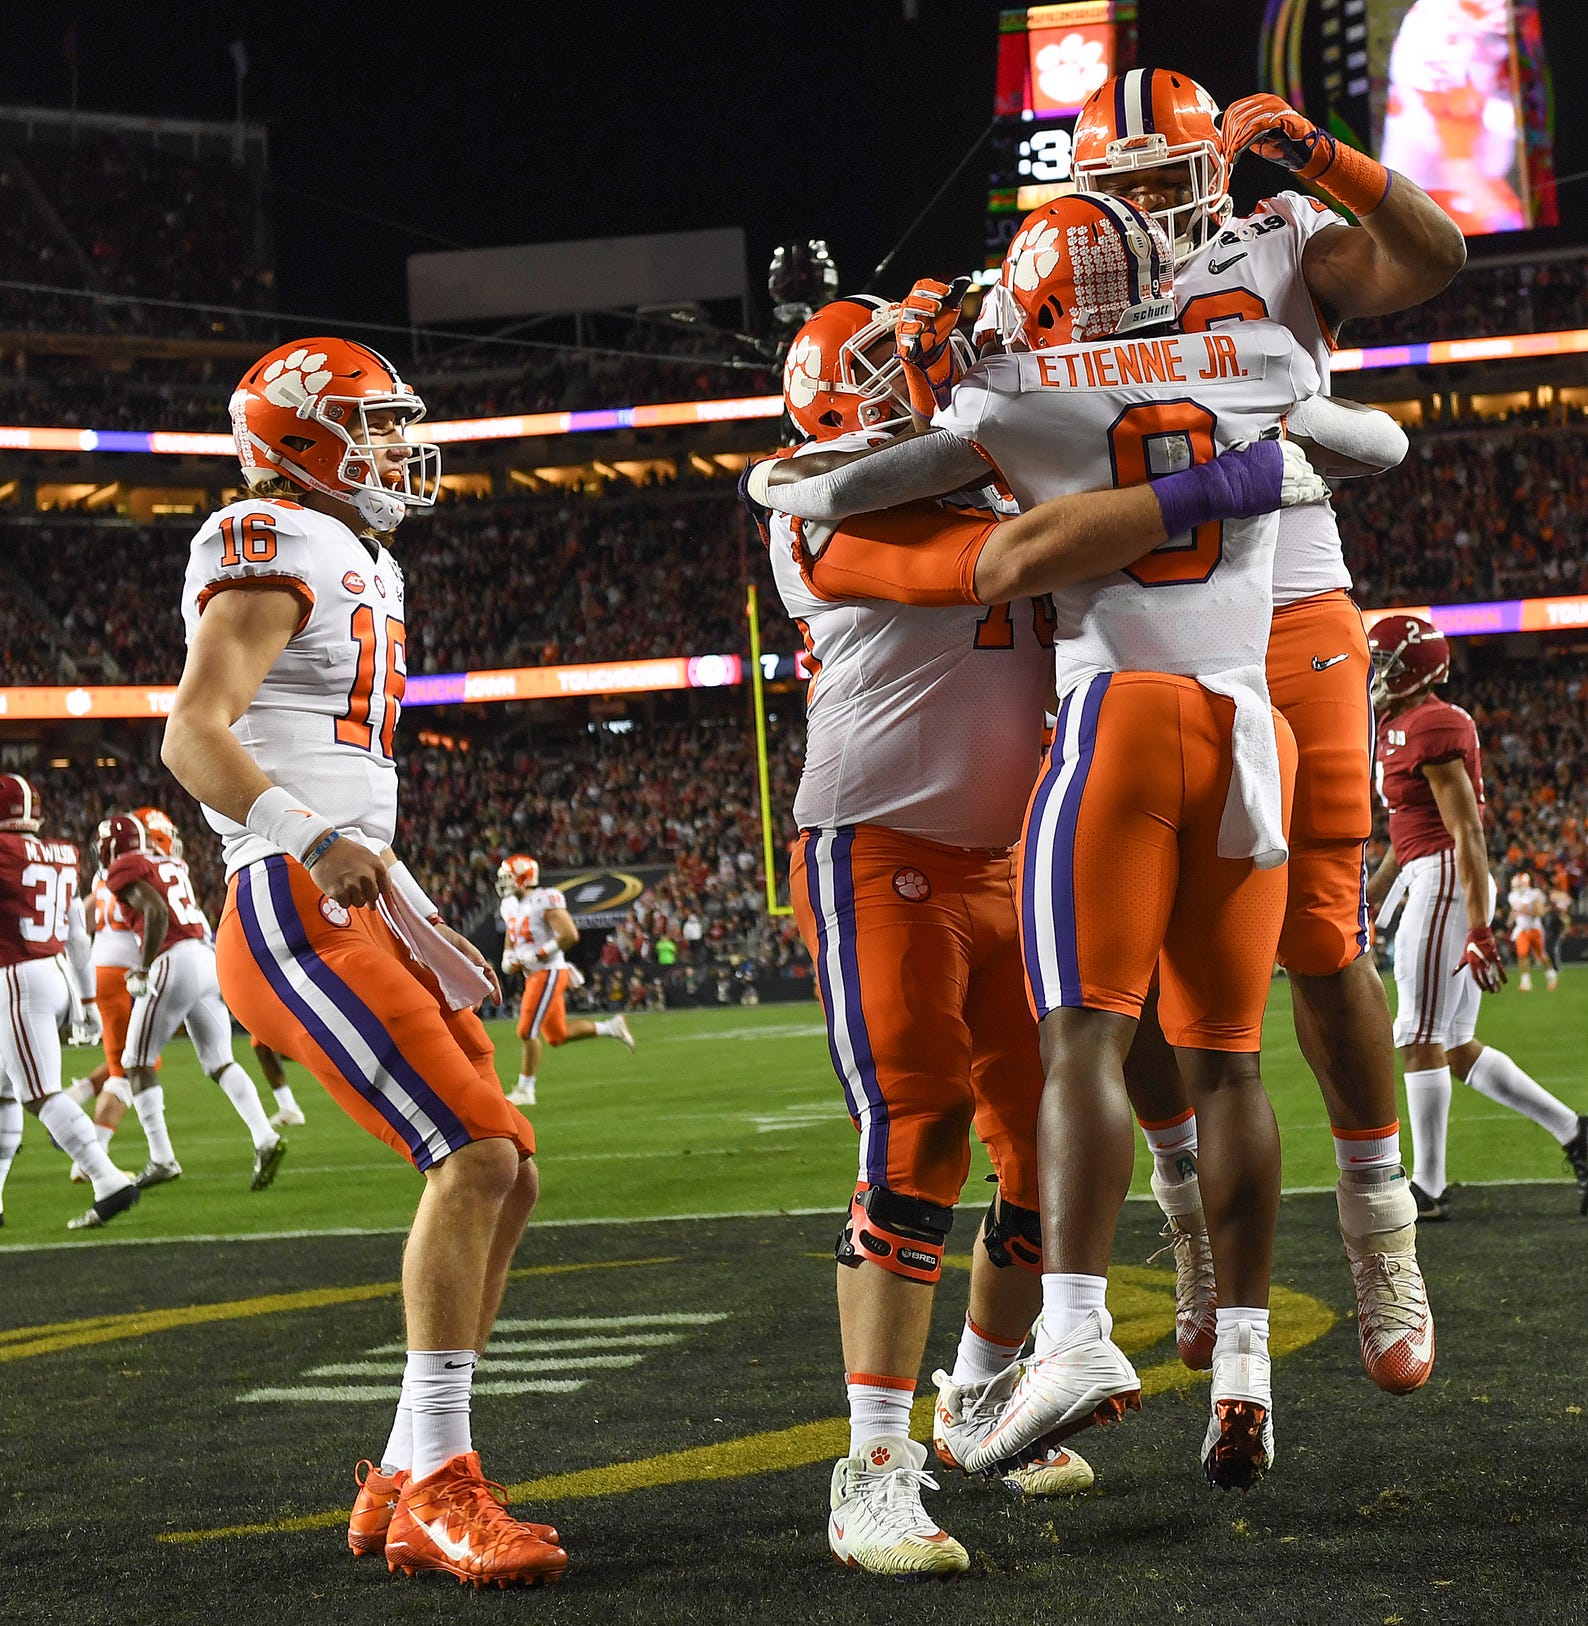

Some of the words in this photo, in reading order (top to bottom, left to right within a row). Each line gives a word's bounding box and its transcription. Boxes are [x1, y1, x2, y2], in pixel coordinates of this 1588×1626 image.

[1152, 279, 1160, 293] 9
[1133, 305, 1169, 321] schutt
[1036, 339, 1186, 387] ETIENNE
[1199, 335, 1248, 379] JR.
[219, 513, 277, 567] 16
[1405, 620, 1421, 644] 2
[557, 665, 678, 692] TOUCHDOWN
[760, 654, 779, 680] 7
[19, 863, 78, 943] 30
[911, 1252, 937, 1265] BREG
